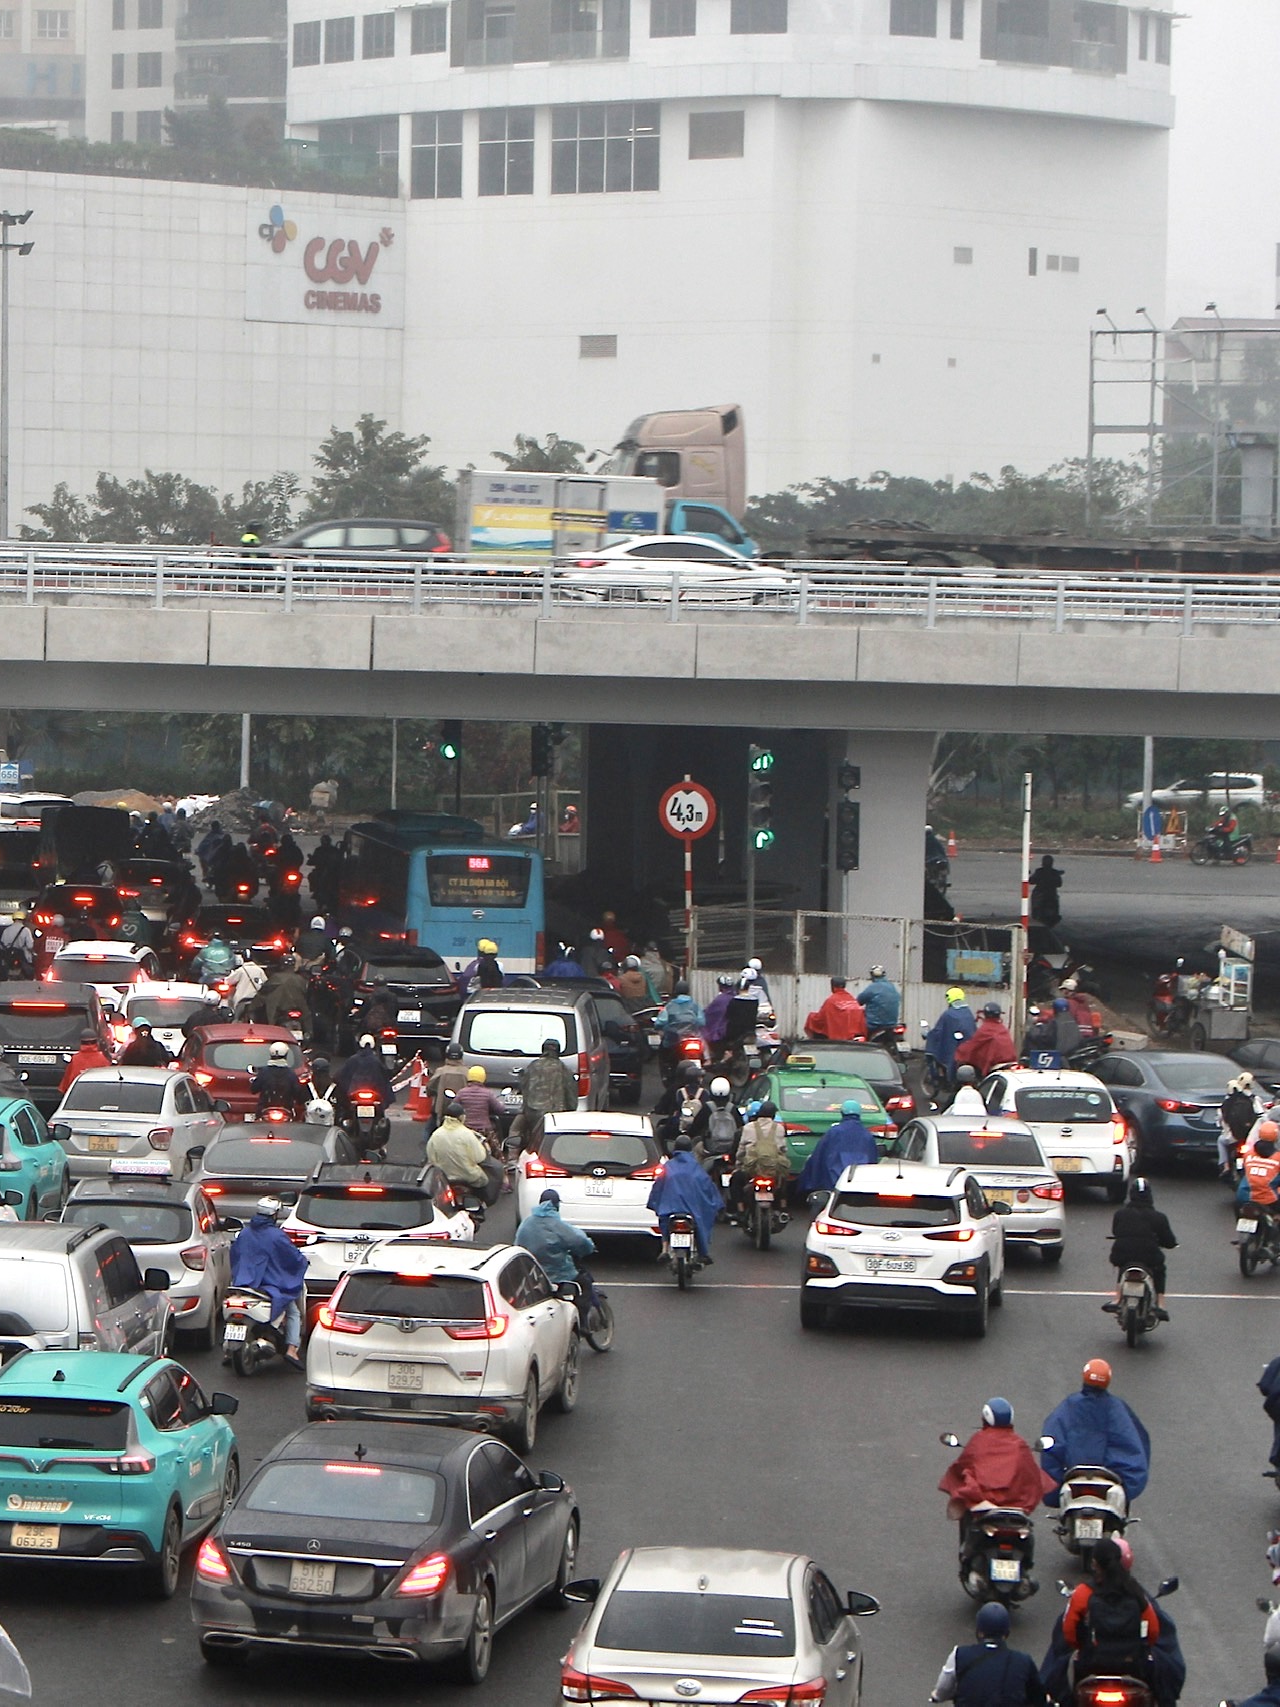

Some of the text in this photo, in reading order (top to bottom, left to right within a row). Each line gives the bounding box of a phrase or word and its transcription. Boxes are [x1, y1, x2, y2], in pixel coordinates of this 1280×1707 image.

[303, 236, 380, 285] CGV
[303, 290, 382, 314] CINEMAS
[1, 771, 18, 779] 656
[468, 857, 489, 869] 56A
[16, 1537, 53, 1548] 063.25
